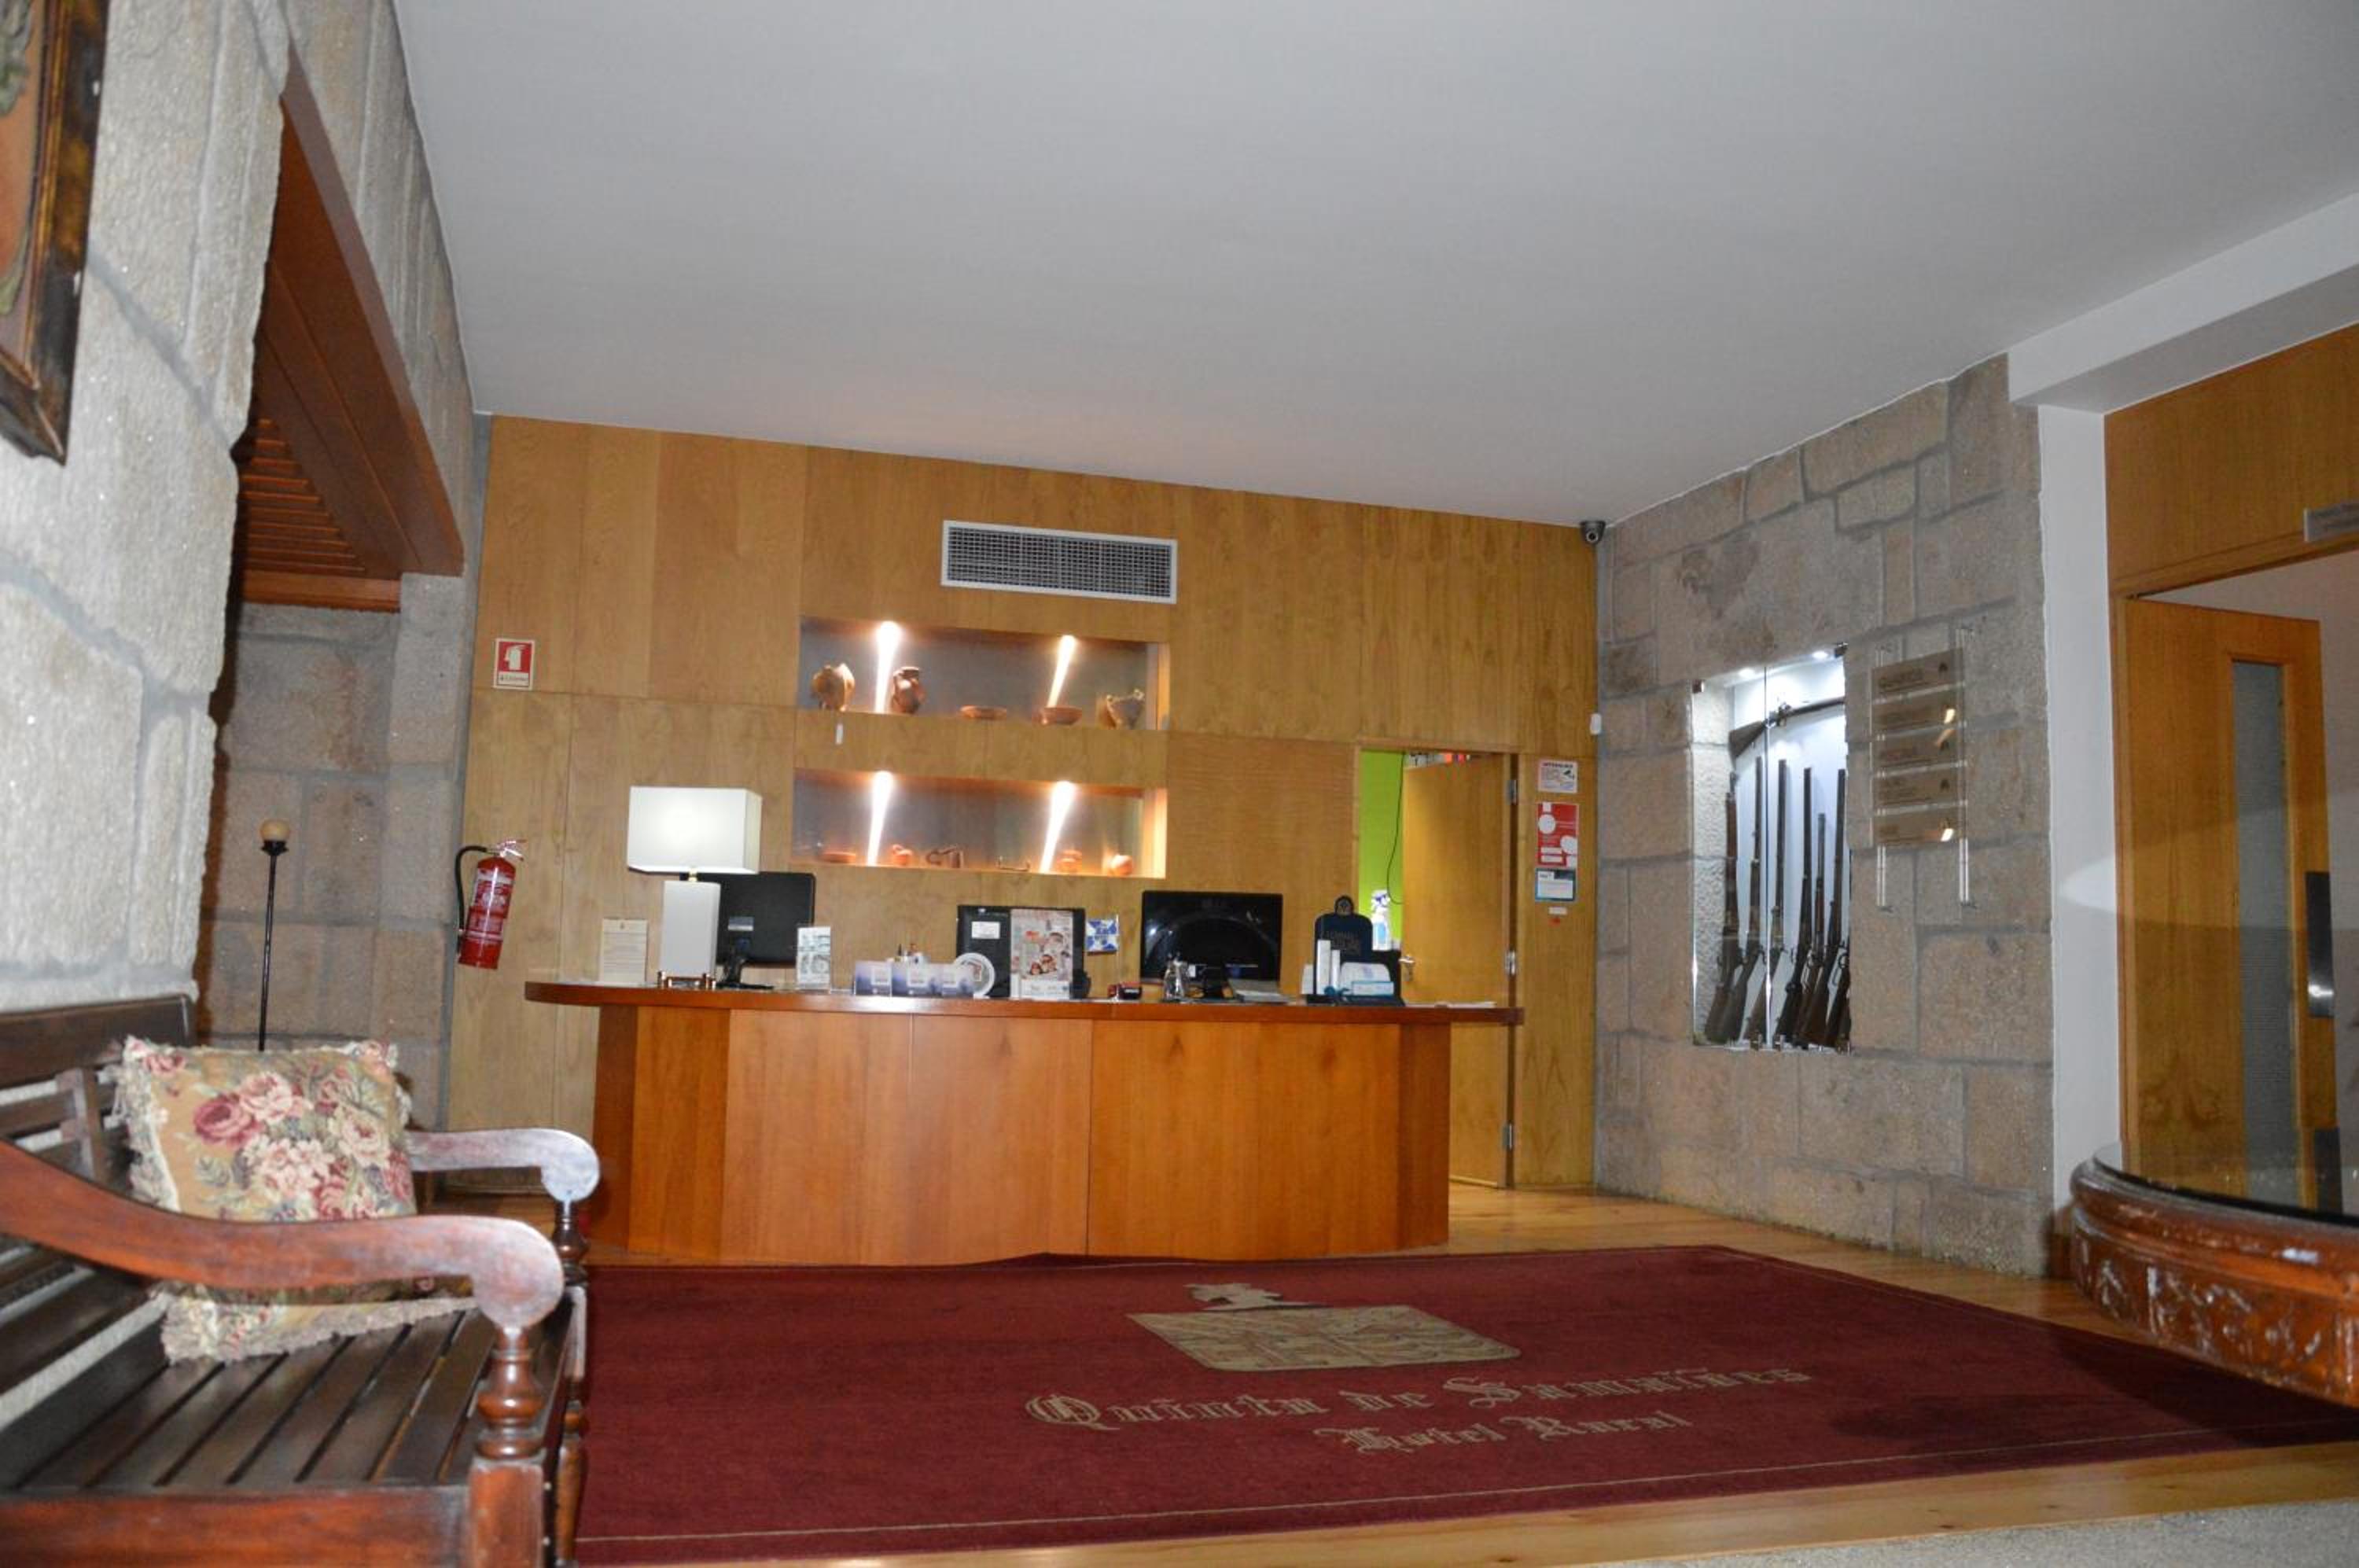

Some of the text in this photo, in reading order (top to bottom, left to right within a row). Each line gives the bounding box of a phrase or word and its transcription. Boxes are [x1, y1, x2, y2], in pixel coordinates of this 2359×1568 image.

[1025, 1393, 1330, 1430] Quinta
[1338, 1390, 1433, 1411] de
[1313, 1410, 1694, 1453] Hotel Rural
